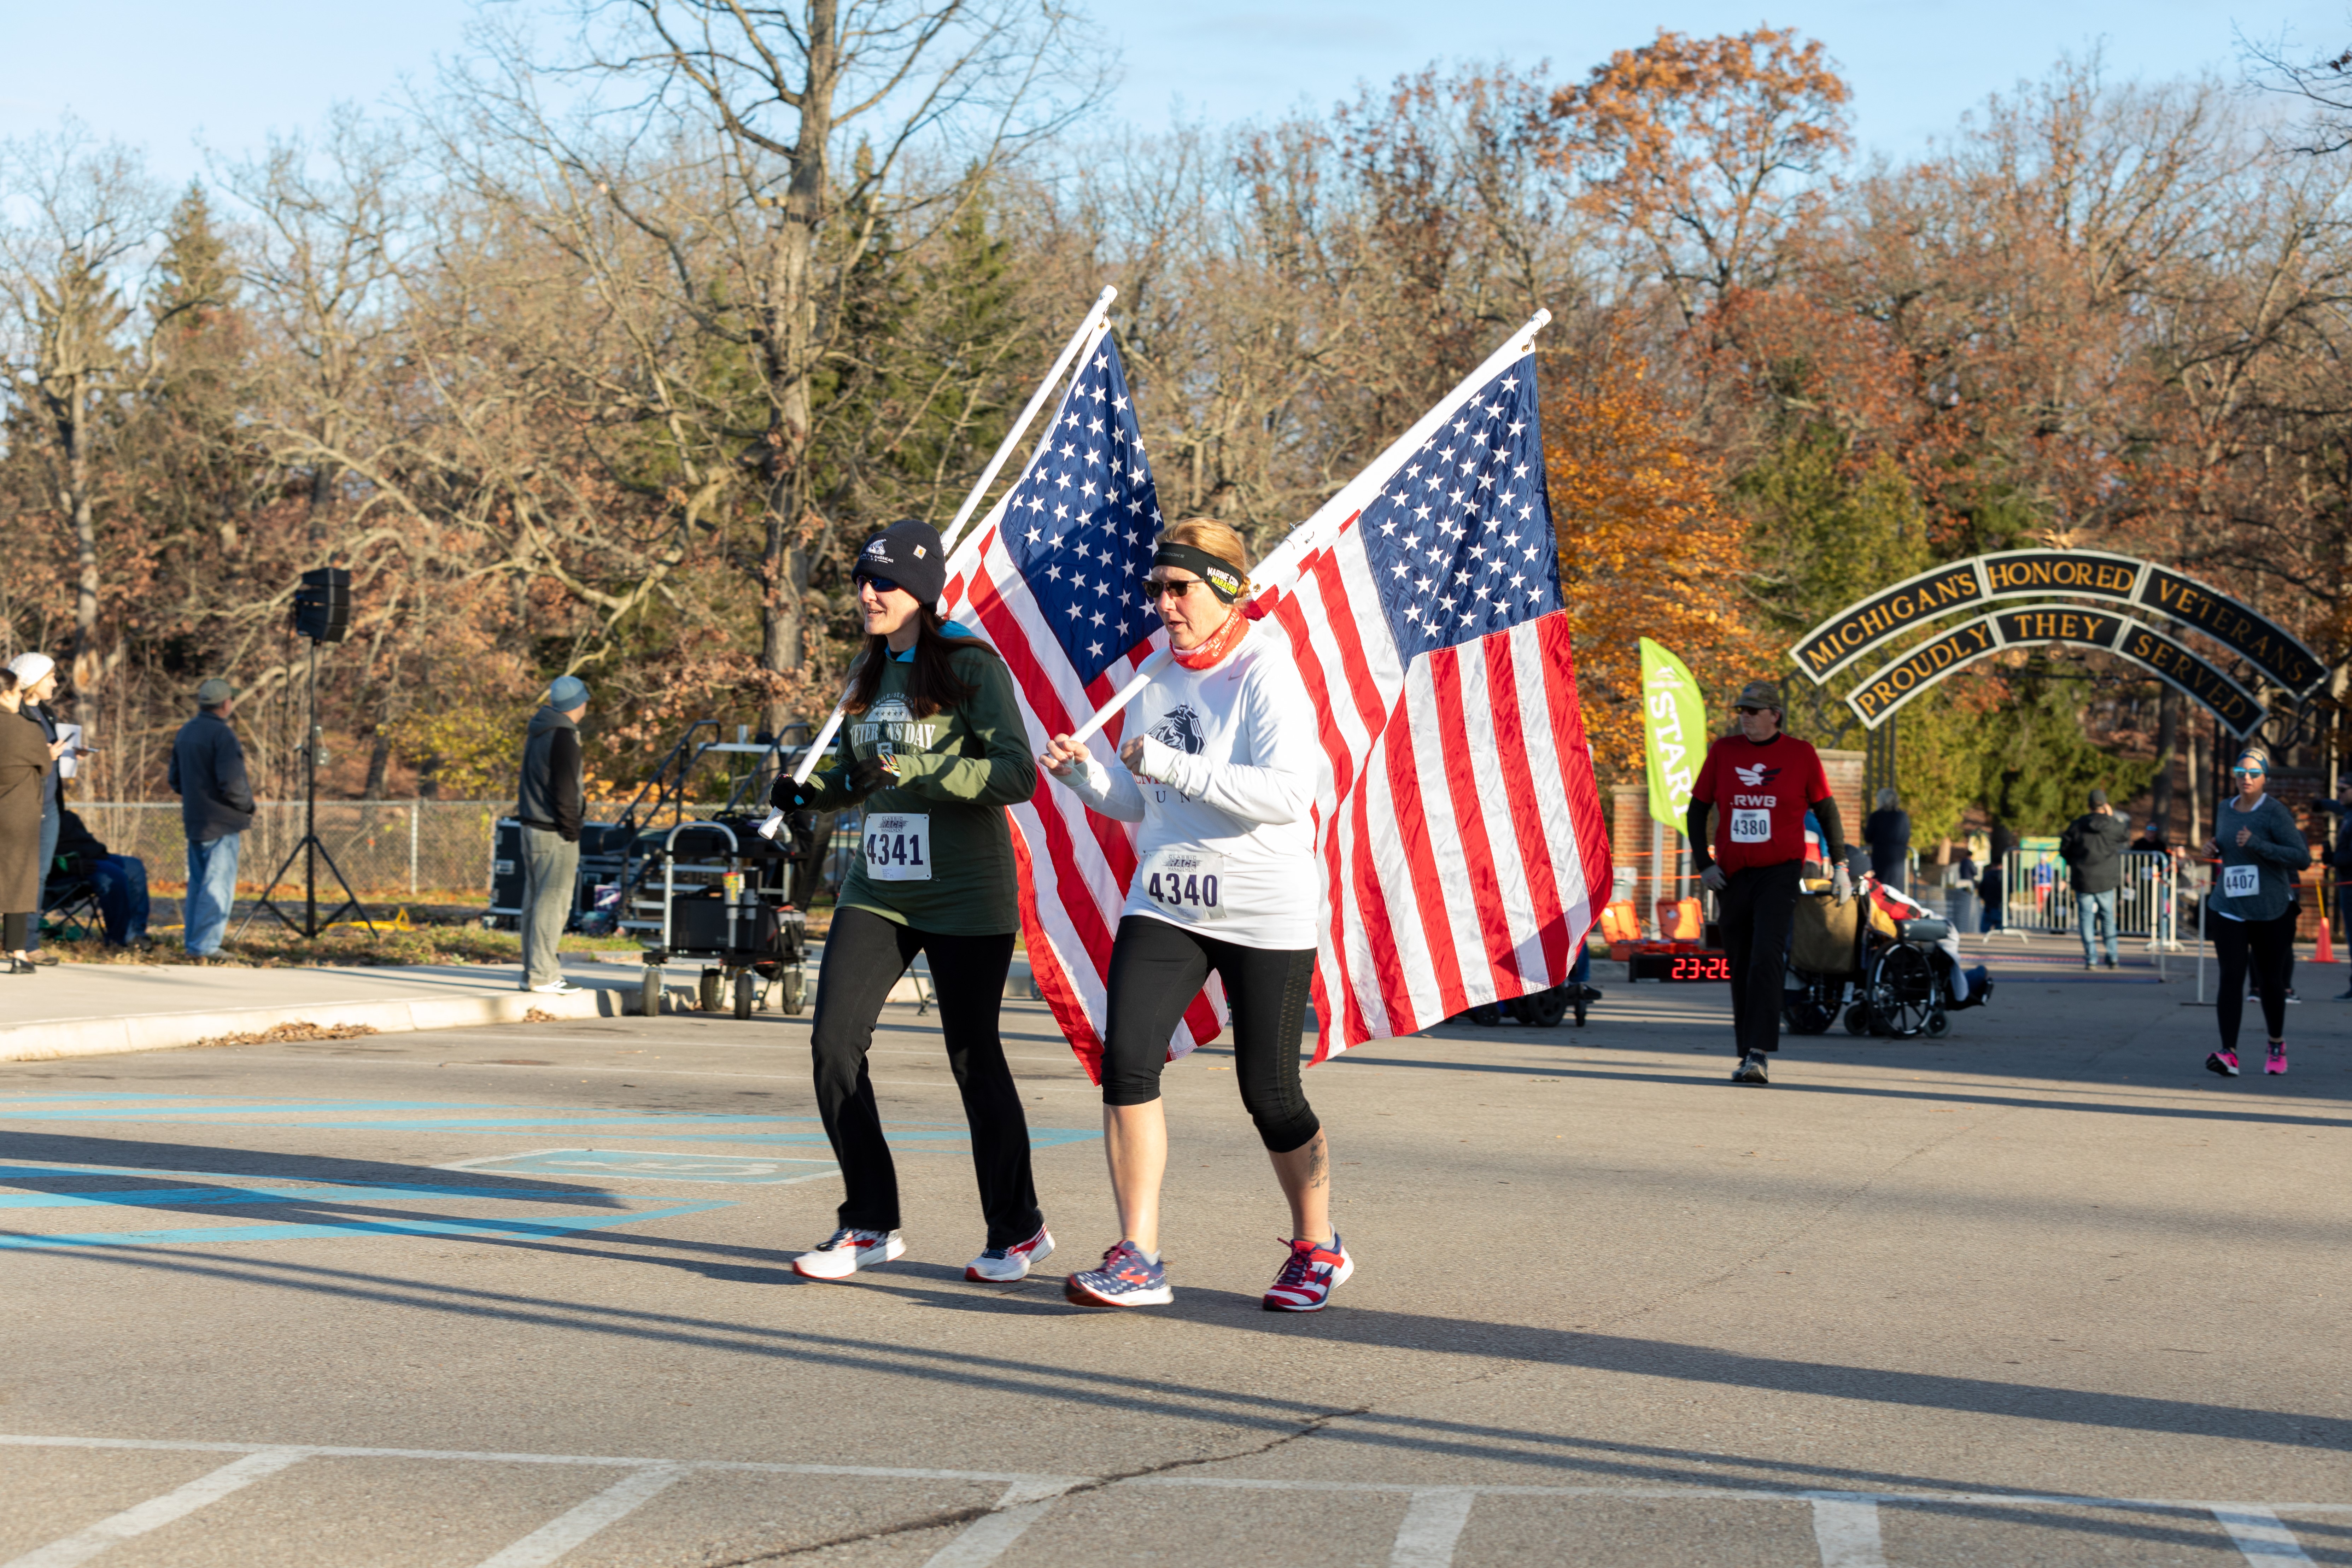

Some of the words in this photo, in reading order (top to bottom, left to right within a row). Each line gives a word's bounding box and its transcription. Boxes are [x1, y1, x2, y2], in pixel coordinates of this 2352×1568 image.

[1207, 566, 1230, 582] MARINE
[1211, 575, 1237, 595] MARATHO
[1807, 573, 1978, 671] MICHIGAN'S
[1987, 561, 2135, 591] HONORED
[2160, 578, 2307, 681] VETERANS
[1857, 624, 1988, 716] PROUDLY
[2014, 614, 2104, 640] THEY
[2134, 634, 2246, 719] SERVED
[849, 723, 904, 749] VETERNS
[904, 723, 936, 751] DAY
[1733, 794, 1777, 808] RWB
[1733, 819, 1767, 835] 4380
[867, 834, 924, 865] 4341
[1170, 859, 1197, 867] RACE
[1149, 872, 1217, 907] 4340
[2226, 874, 2255, 890] 4407
